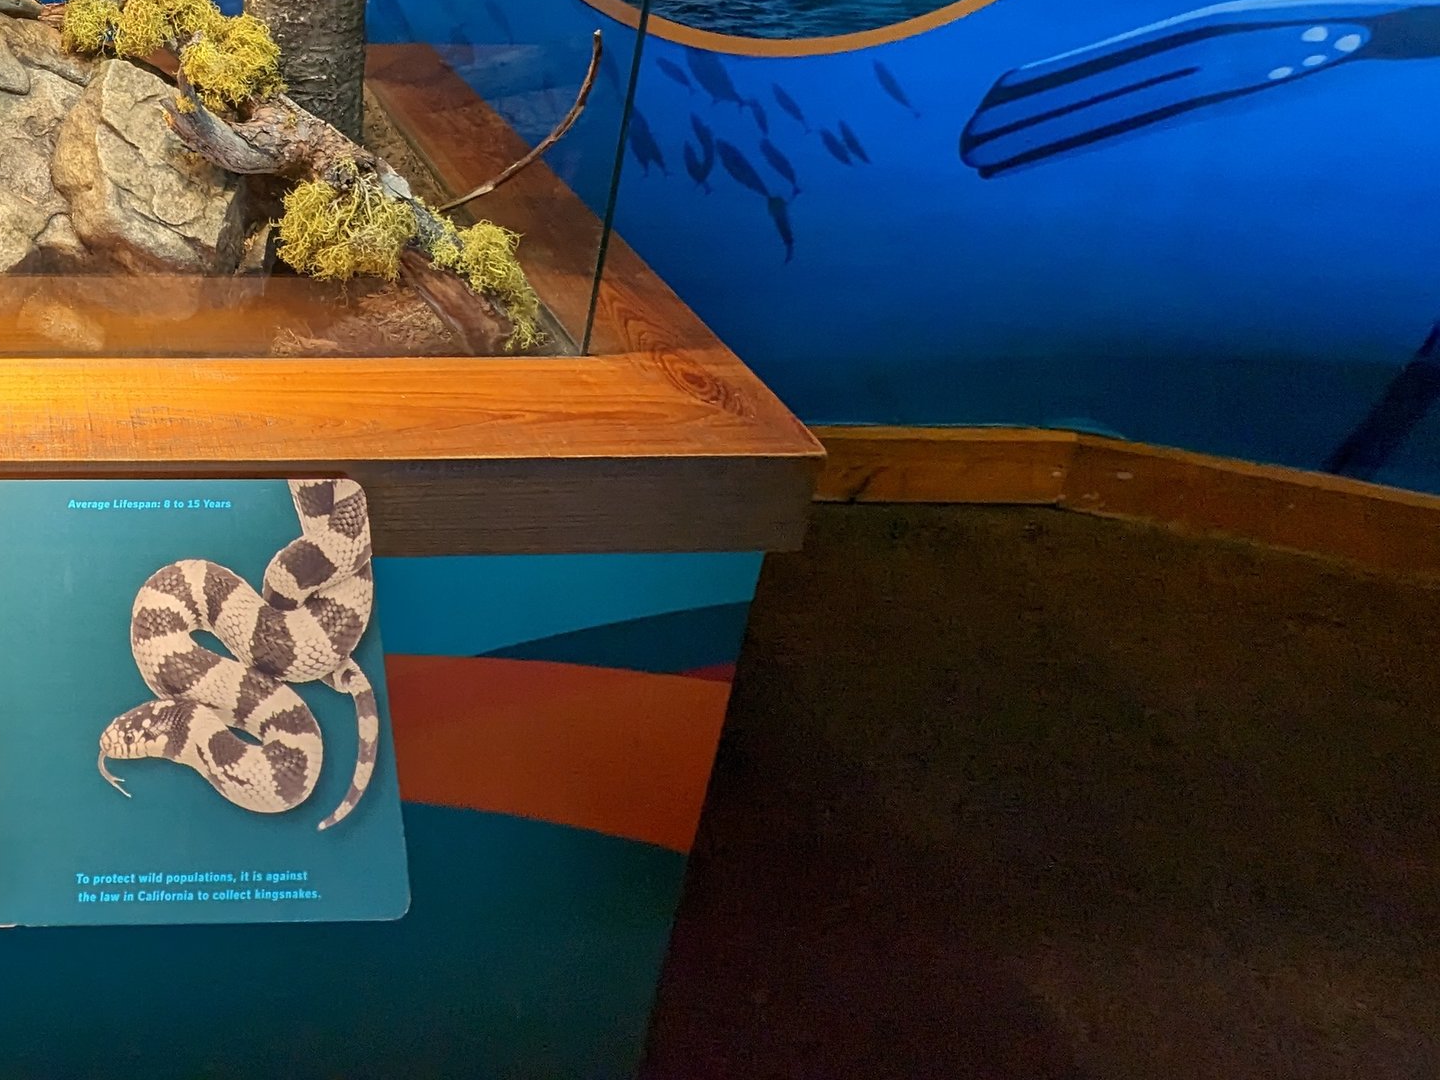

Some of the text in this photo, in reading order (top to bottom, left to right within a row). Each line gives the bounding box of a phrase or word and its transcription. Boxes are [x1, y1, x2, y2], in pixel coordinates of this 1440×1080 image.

[67, 499, 231, 509] Average Lifespan: 8 to 15 Years
[76, 870, 307, 885] To protect wild populations, it is against
[78, 888, 321, 901] the law in California to collect kingsnakes.
